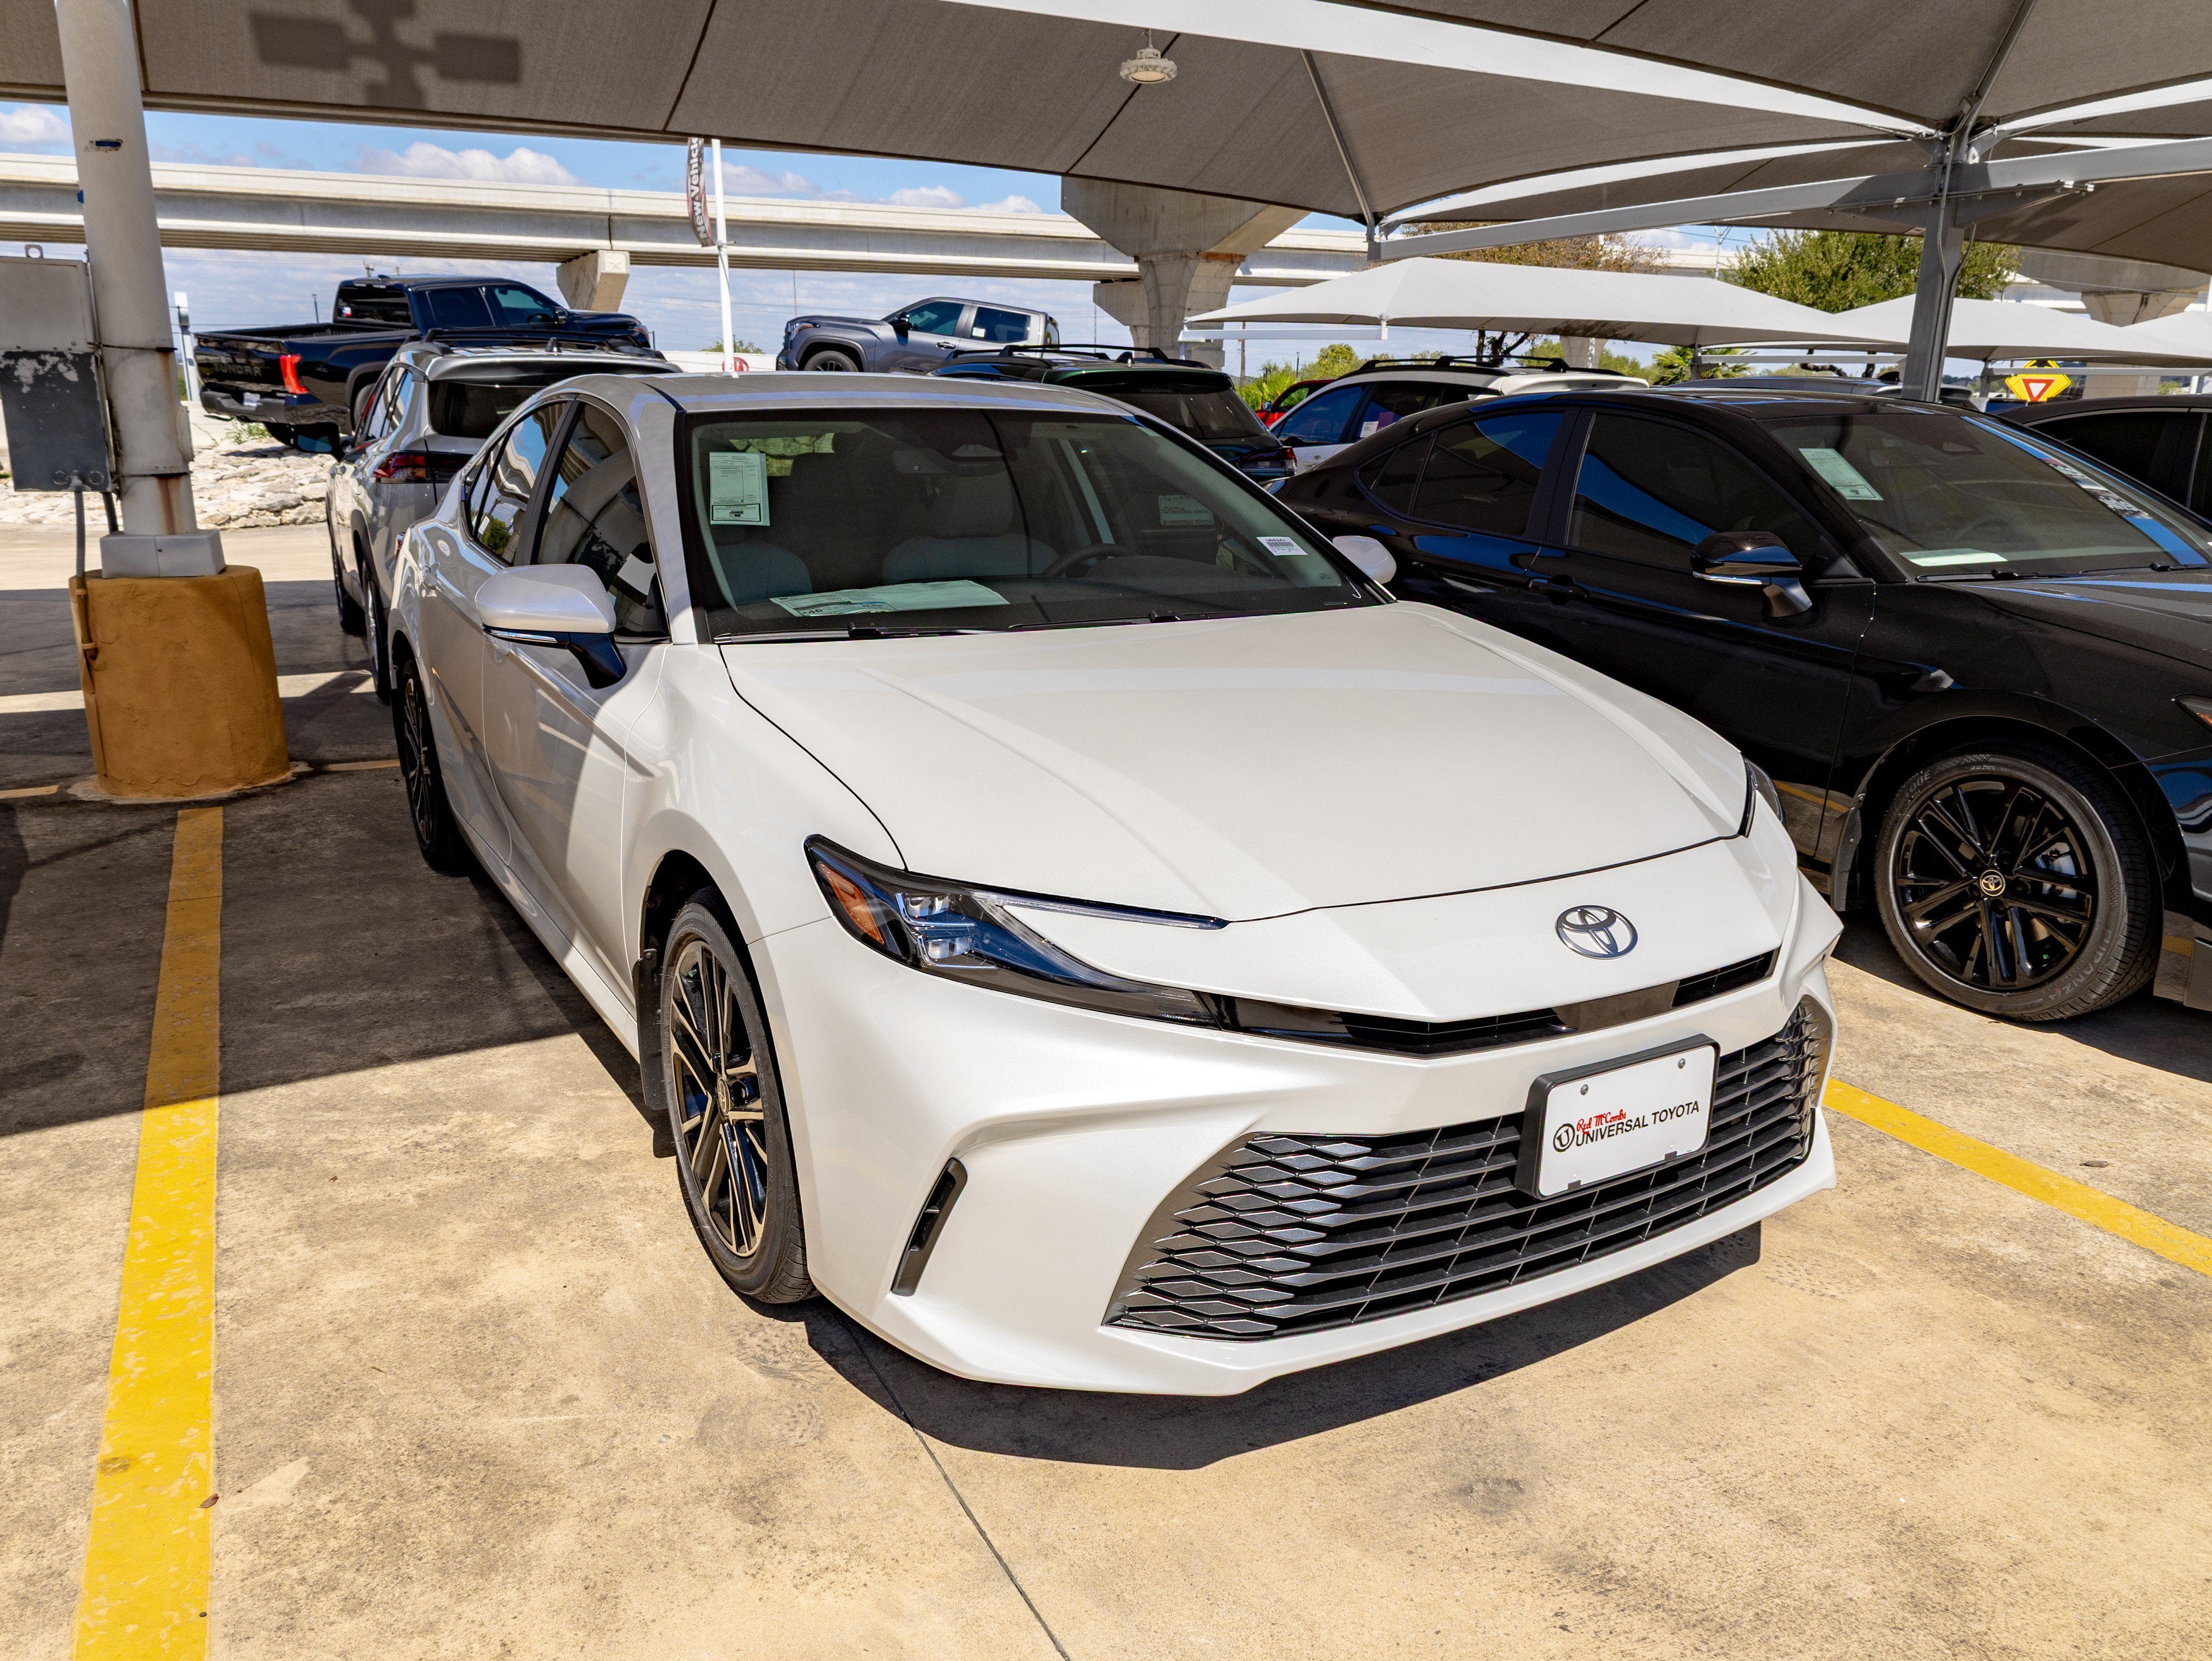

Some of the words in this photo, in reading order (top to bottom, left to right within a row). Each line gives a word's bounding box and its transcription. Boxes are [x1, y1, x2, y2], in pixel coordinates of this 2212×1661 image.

[694, 202, 707, 239] New
[1575, 1116, 1649, 1147] UNIVERSAL
[1652, 1100, 1699, 1125] TOYOTA
[1577, 1118, 1592, 1134] Red
[1593, 1109, 1627, 1126] McCombs
